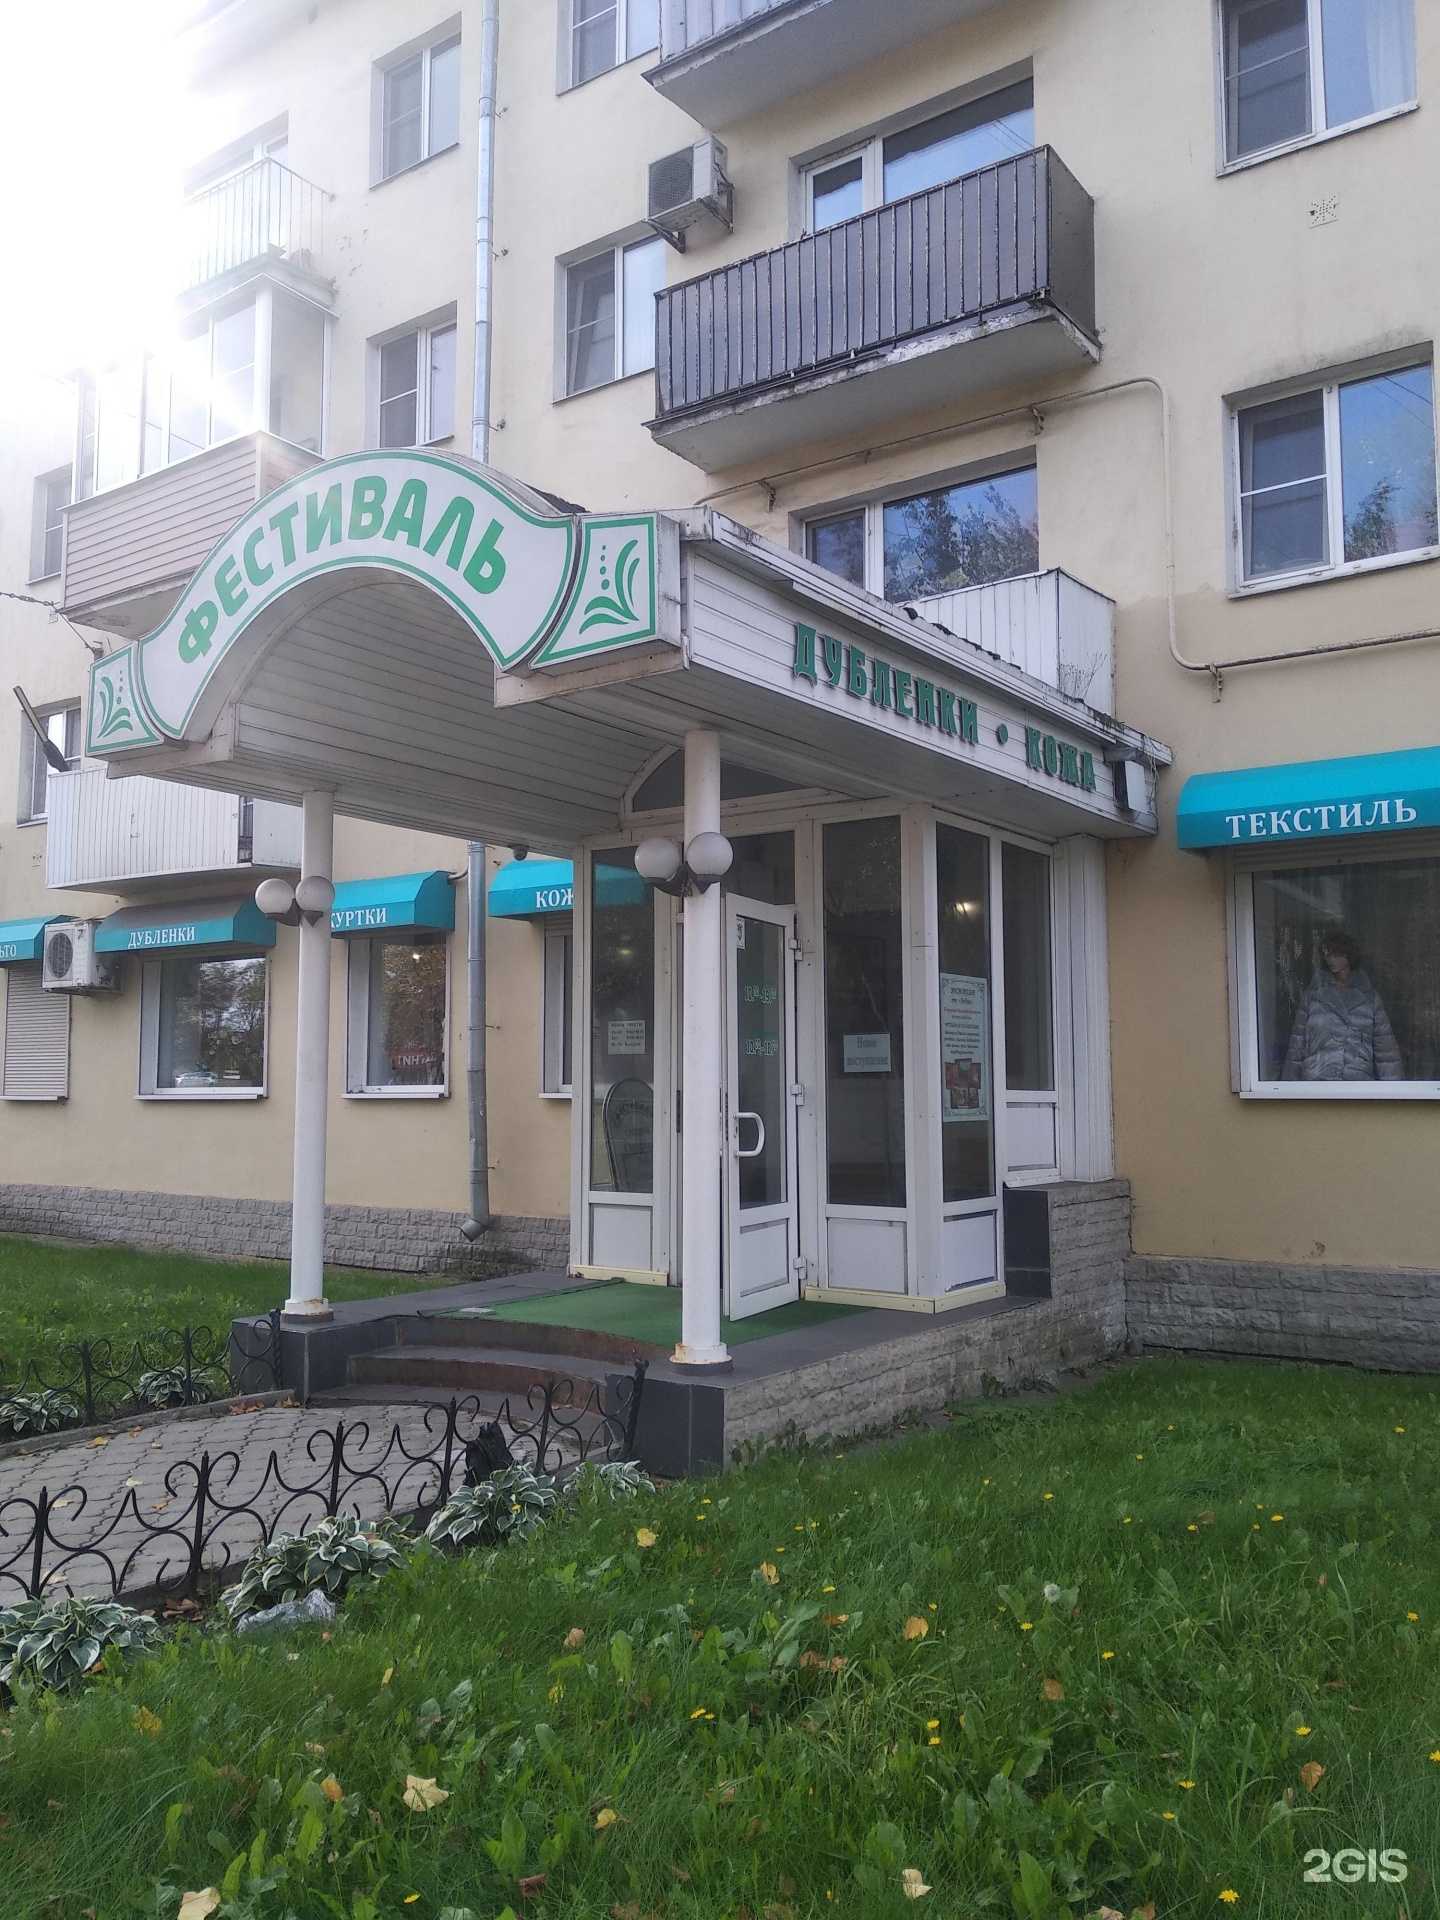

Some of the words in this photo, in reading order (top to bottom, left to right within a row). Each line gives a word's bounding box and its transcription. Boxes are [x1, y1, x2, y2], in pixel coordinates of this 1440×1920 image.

[178, 475, 506, 663] ФЕСТИВАЛЬ
[793, 622, 979, 745] ДУБЛЕНКИ
[1024, 726, 1097, 792] КОЖА
[1225, 798, 1418, 838] ТЕКСТИЛЬ
[127, 926, 196, 949] ДУБЛЕНКИ
